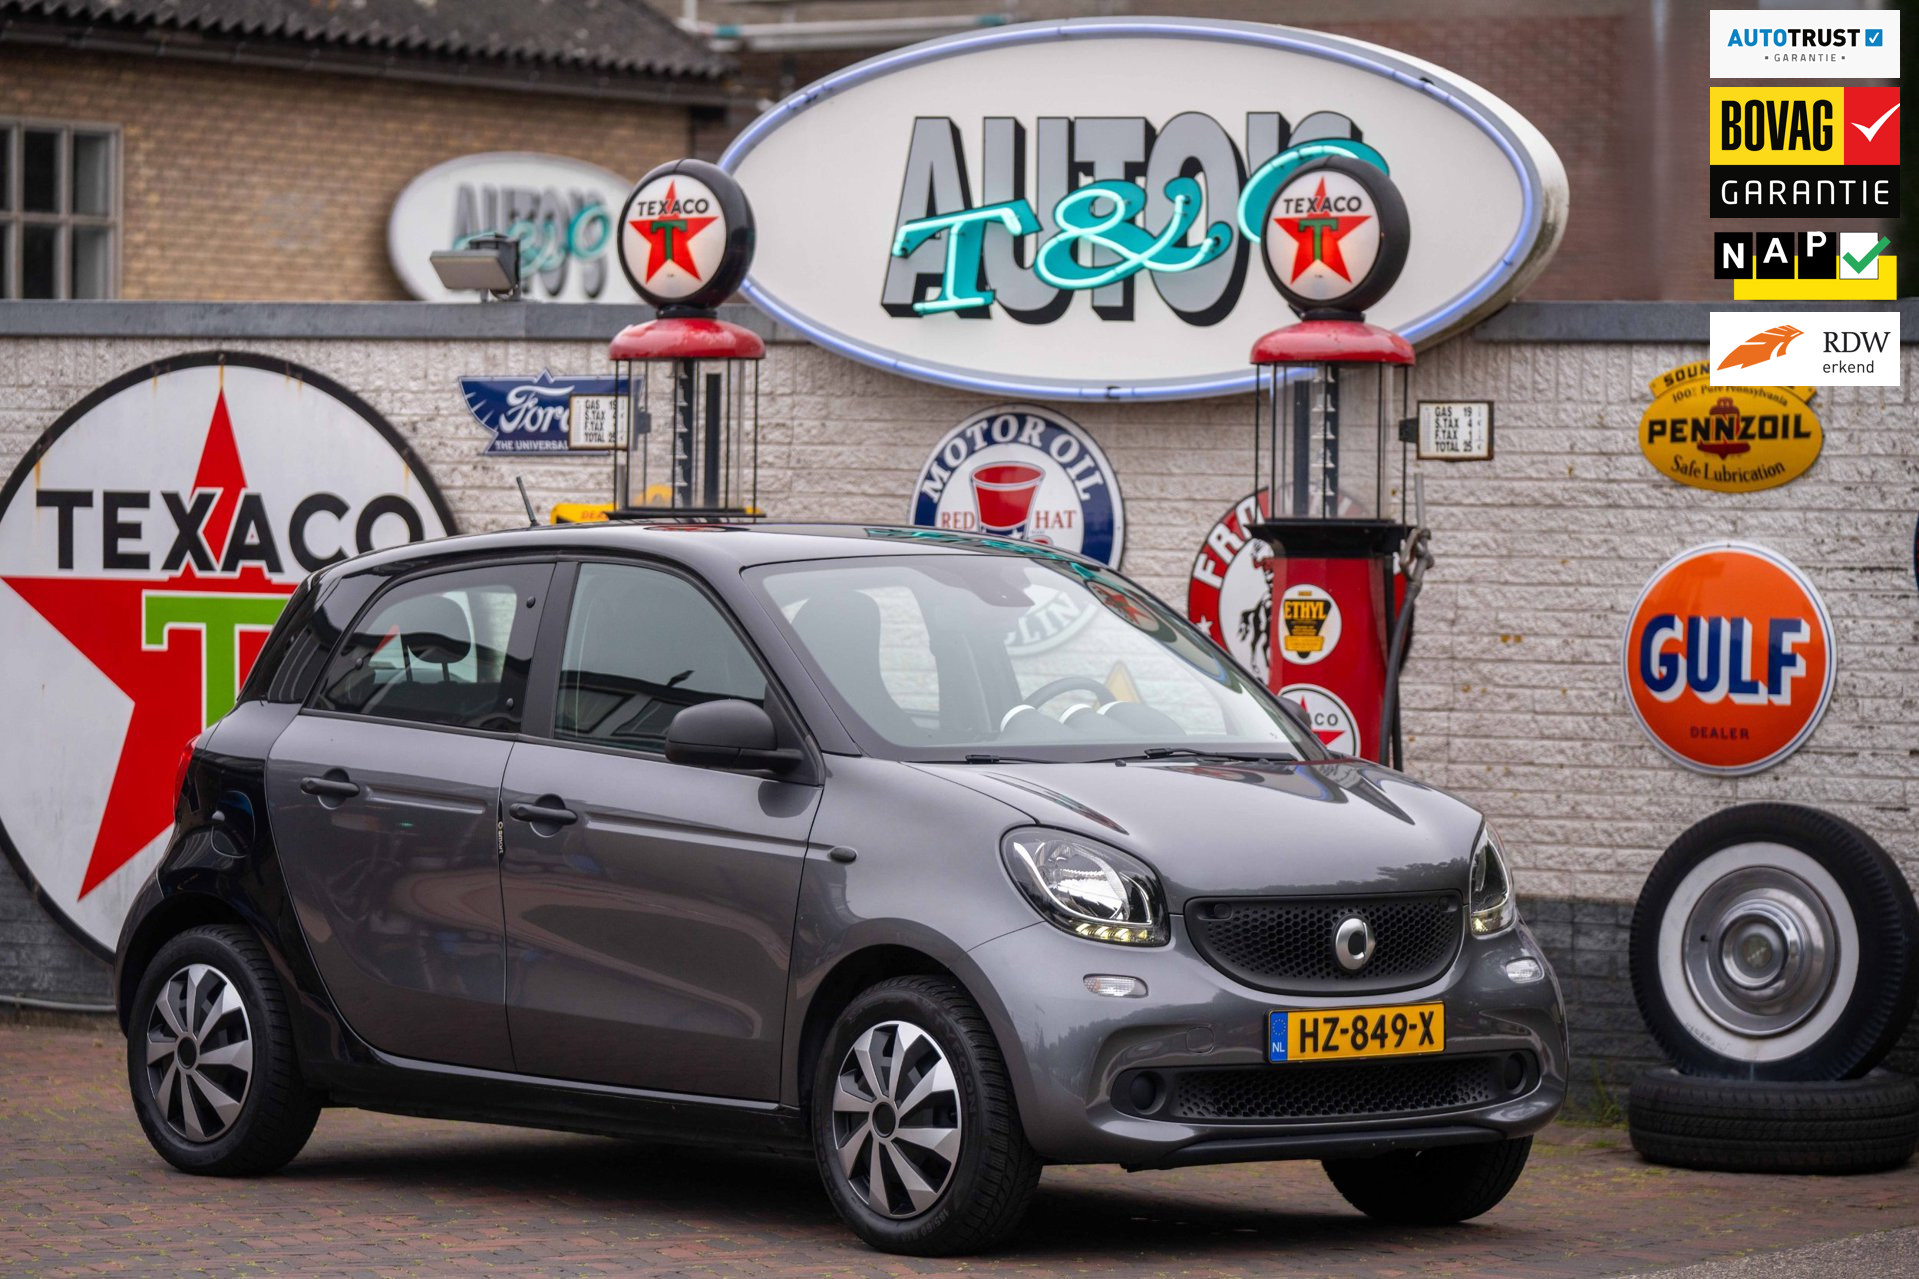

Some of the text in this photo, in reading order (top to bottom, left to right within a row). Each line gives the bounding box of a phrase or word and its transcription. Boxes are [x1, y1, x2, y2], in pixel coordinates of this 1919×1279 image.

[637, 199, 709, 216] TEXACO
[1284, 196, 1362, 214] TEXACO
[881, 111, 1363, 326] AUTO'
[585, 400, 600, 410] GAS
[1435, 406, 1452, 417] GAS
[584, 411, 605, 420] S.TAX
[1434, 418, 1459, 429] S.TAX
[584, 421, 604, 431] F.TAX
[1648, 414, 1811, 443] PENNZOIL
[584, 432, 605, 443] TOTAL
[1434, 430, 1458, 440] F.TAX
[495, 440, 514, 450] THE
[1434, 441, 1472, 452] TOTAL 25
[922, 414, 1103, 503] MOTOR OIL
[1671, 455, 1786, 484] Safe Lubrication
[941, 511, 975, 529] RED
[1035, 510, 1077, 529] HAT
[35, 490, 424, 573] TEXACO
[1284, 601, 1326, 619] ETHYL
[1640, 613, 1810, 705] GULF
[1690, 726, 1749, 739] DEALER
[1300, 1010, 1435, 1053] HZ-849-X
[1272, 1042, 1285, 1053] NL
